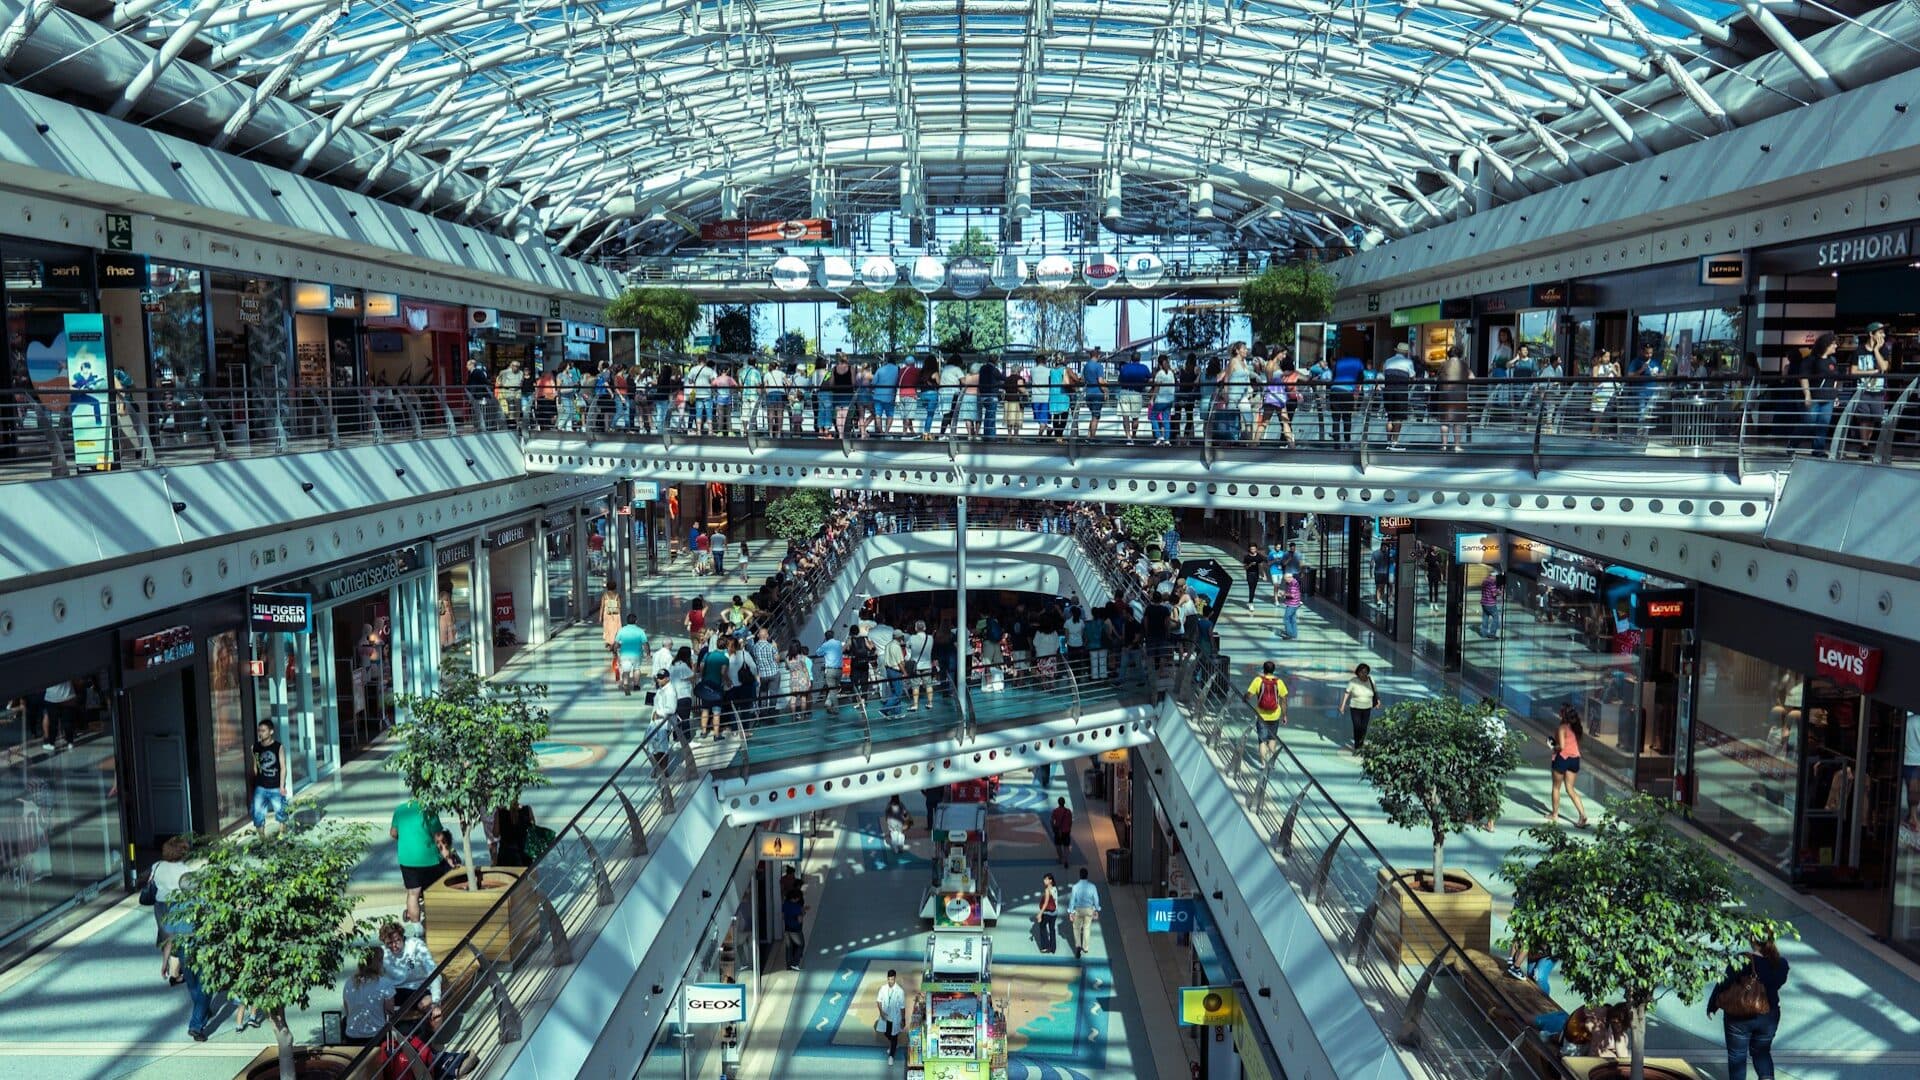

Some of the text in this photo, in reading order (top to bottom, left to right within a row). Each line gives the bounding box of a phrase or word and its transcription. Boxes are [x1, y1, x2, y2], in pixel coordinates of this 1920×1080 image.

[1818, 232, 1907, 266] SEPHORA
[106, 265, 135, 276] fnac
[497, 527, 524, 546] CORTEFIEL
[437, 545, 470, 567] CORTEFIEL
[1540, 558, 1597, 594] Samsonite
[252, 603, 305, 615] HILFIGER
[272, 614, 305, 623] DENIM
[1155, 910, 1188, 922] MEO
[688, 999, 741, 1010] GEOX
